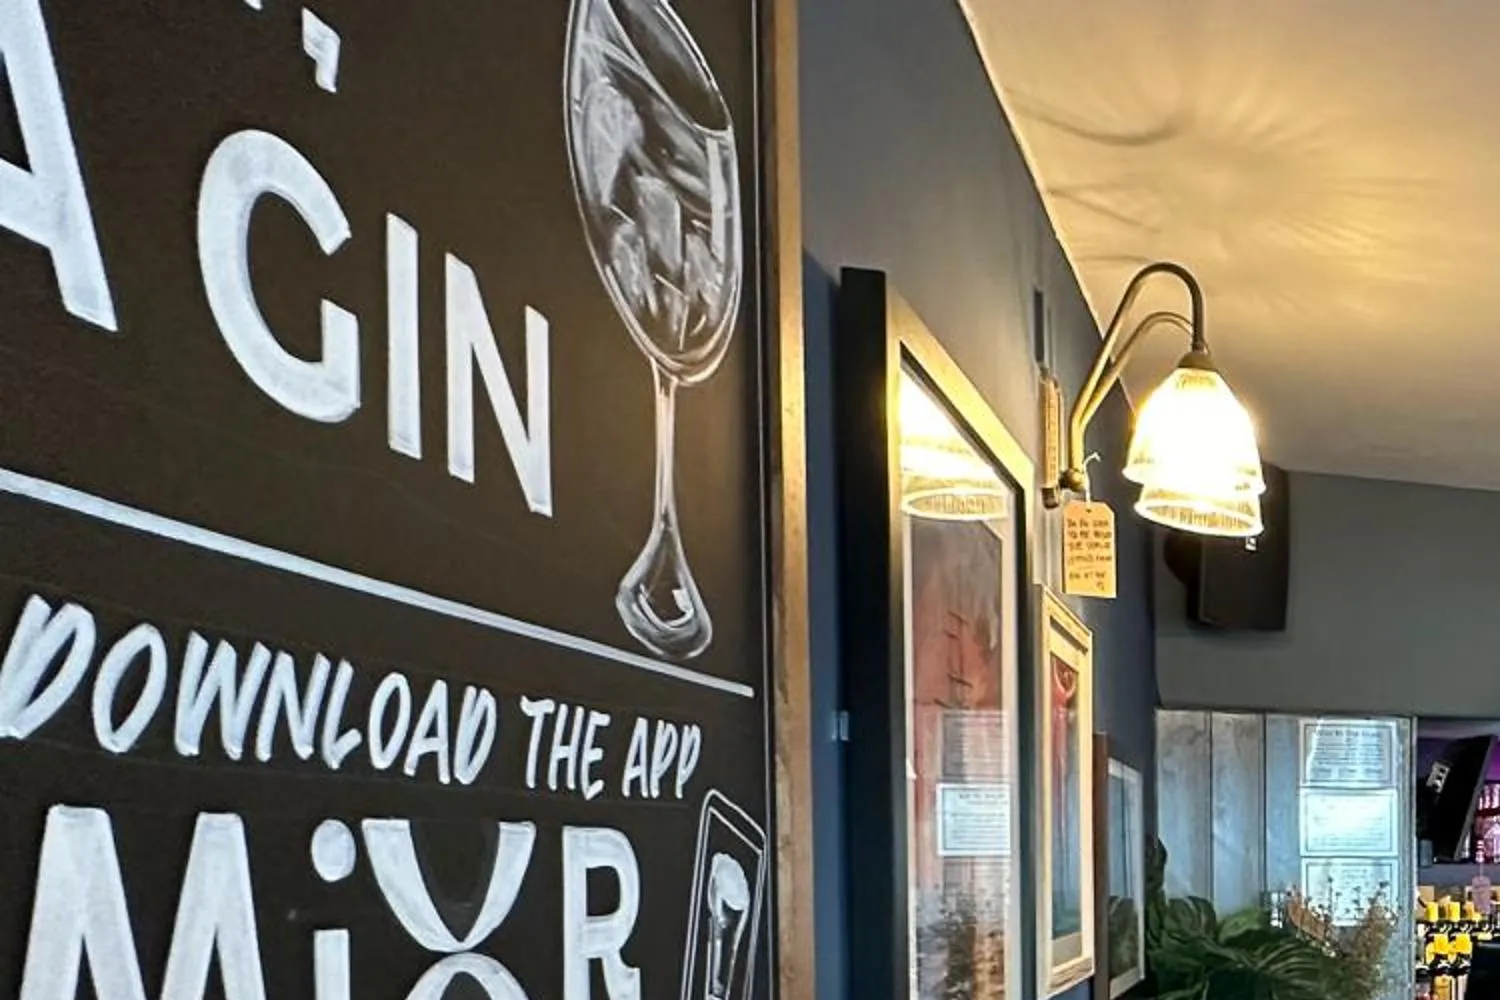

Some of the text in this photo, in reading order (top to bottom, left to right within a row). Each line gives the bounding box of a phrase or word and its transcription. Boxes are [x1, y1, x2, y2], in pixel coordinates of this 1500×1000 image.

[197, 130, 552, 518] GIN
[0, 594, 701, 800] DOWNLOAD THE APP
